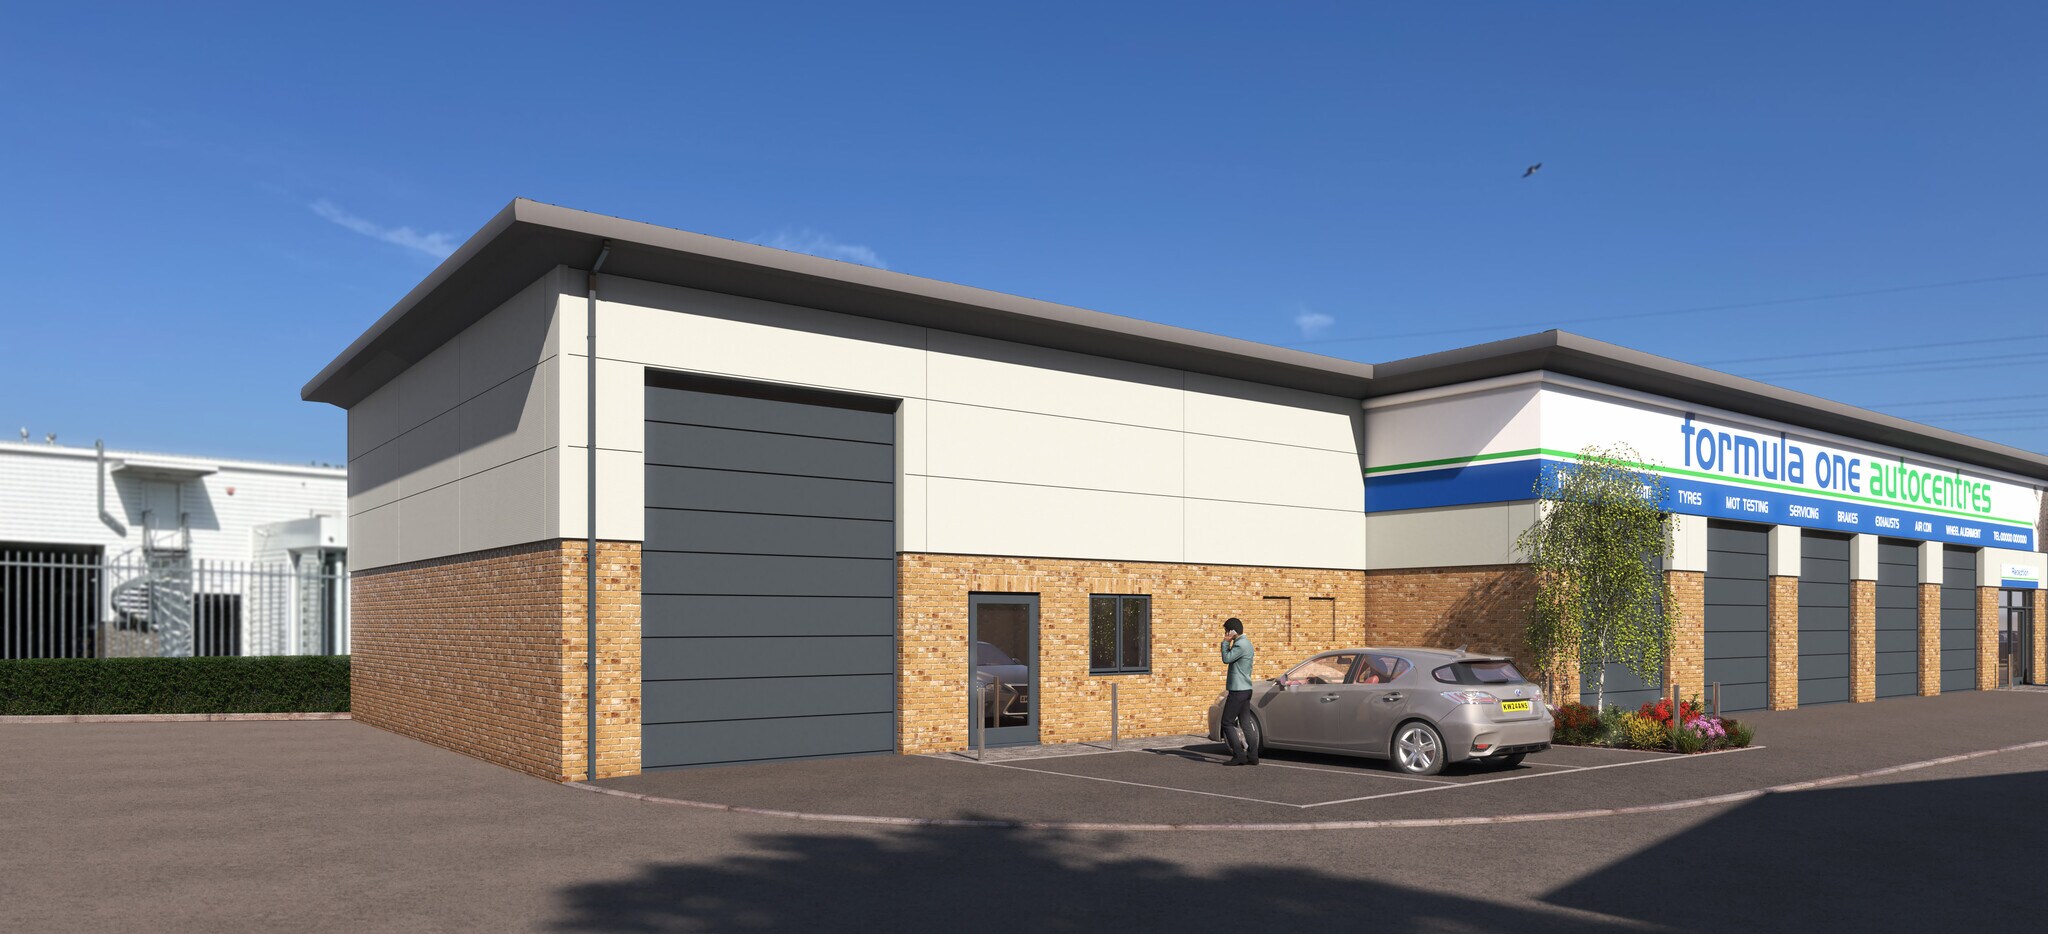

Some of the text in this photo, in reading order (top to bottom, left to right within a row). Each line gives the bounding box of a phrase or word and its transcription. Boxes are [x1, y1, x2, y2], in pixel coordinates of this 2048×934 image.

[1681, 411, 1804, 485] formula
[1815, 451, 1861, 493] one
[1870, 457, 1991, 513] autocentres
[1678, 490, 1702, 505] TYRES
[1726, 496, 1768, 513] MOT TESTING
[1789, 504, 1819, 519] SERVICING
[1837, 510, 1858, 524] BRAKES
[1875, 515, 1900, 530] EXHAUSTS
[1915, 521, 1932, 533] AIR CON
[1945, 525, 1981, 539] WHEEL ALIGNMENT
